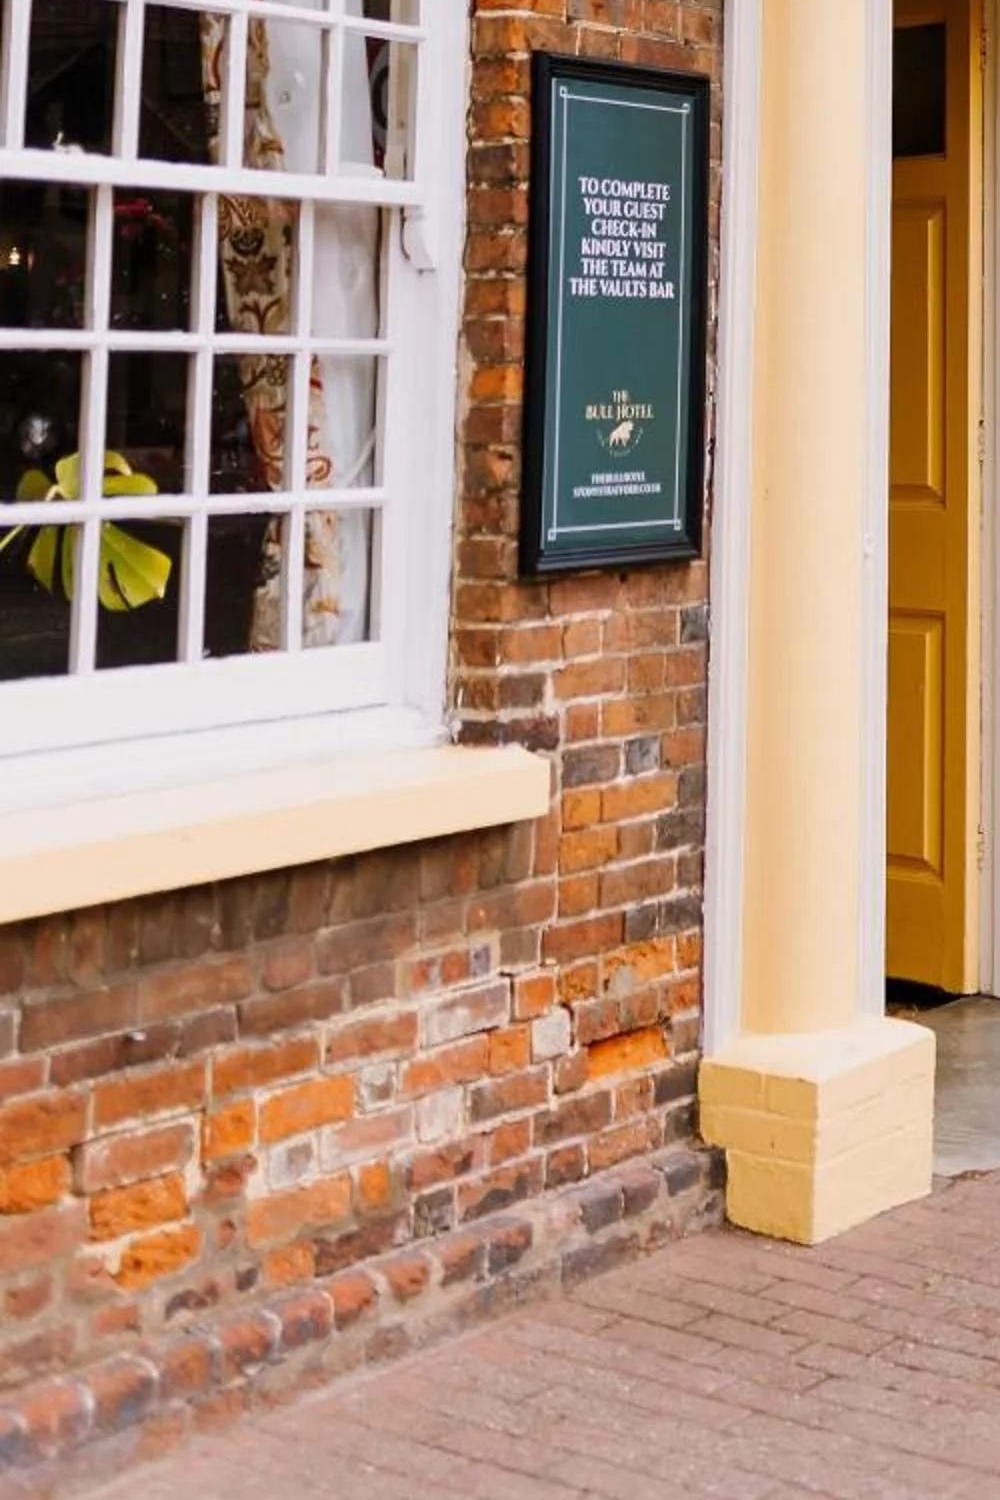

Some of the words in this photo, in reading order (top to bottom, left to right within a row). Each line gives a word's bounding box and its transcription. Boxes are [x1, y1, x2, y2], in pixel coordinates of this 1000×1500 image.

[578, 176, 599, 195] TO
[601, 179, 671, 201] COMPLETE
[583, 197, 622, 217] YOUR
[623, 200, 666, 221] GUEST
[591, 218, 657, 238] CHECK-IN
[581, 237, 630, 257] KINDLY
[633, 241, 666, 259] VISIT
[581, 258, 608, 277] THE
[609, 259, 647, 278] TEAM
[649, 262, 666, 279] AT
[569, 277, 597, 296] THE
[599, 279, 647, 298] VAULTS
[649, 281, 674, 299] BAR
[585, 404, 614, 420] BULL
[616, 403, 654, 421] HOTEL
